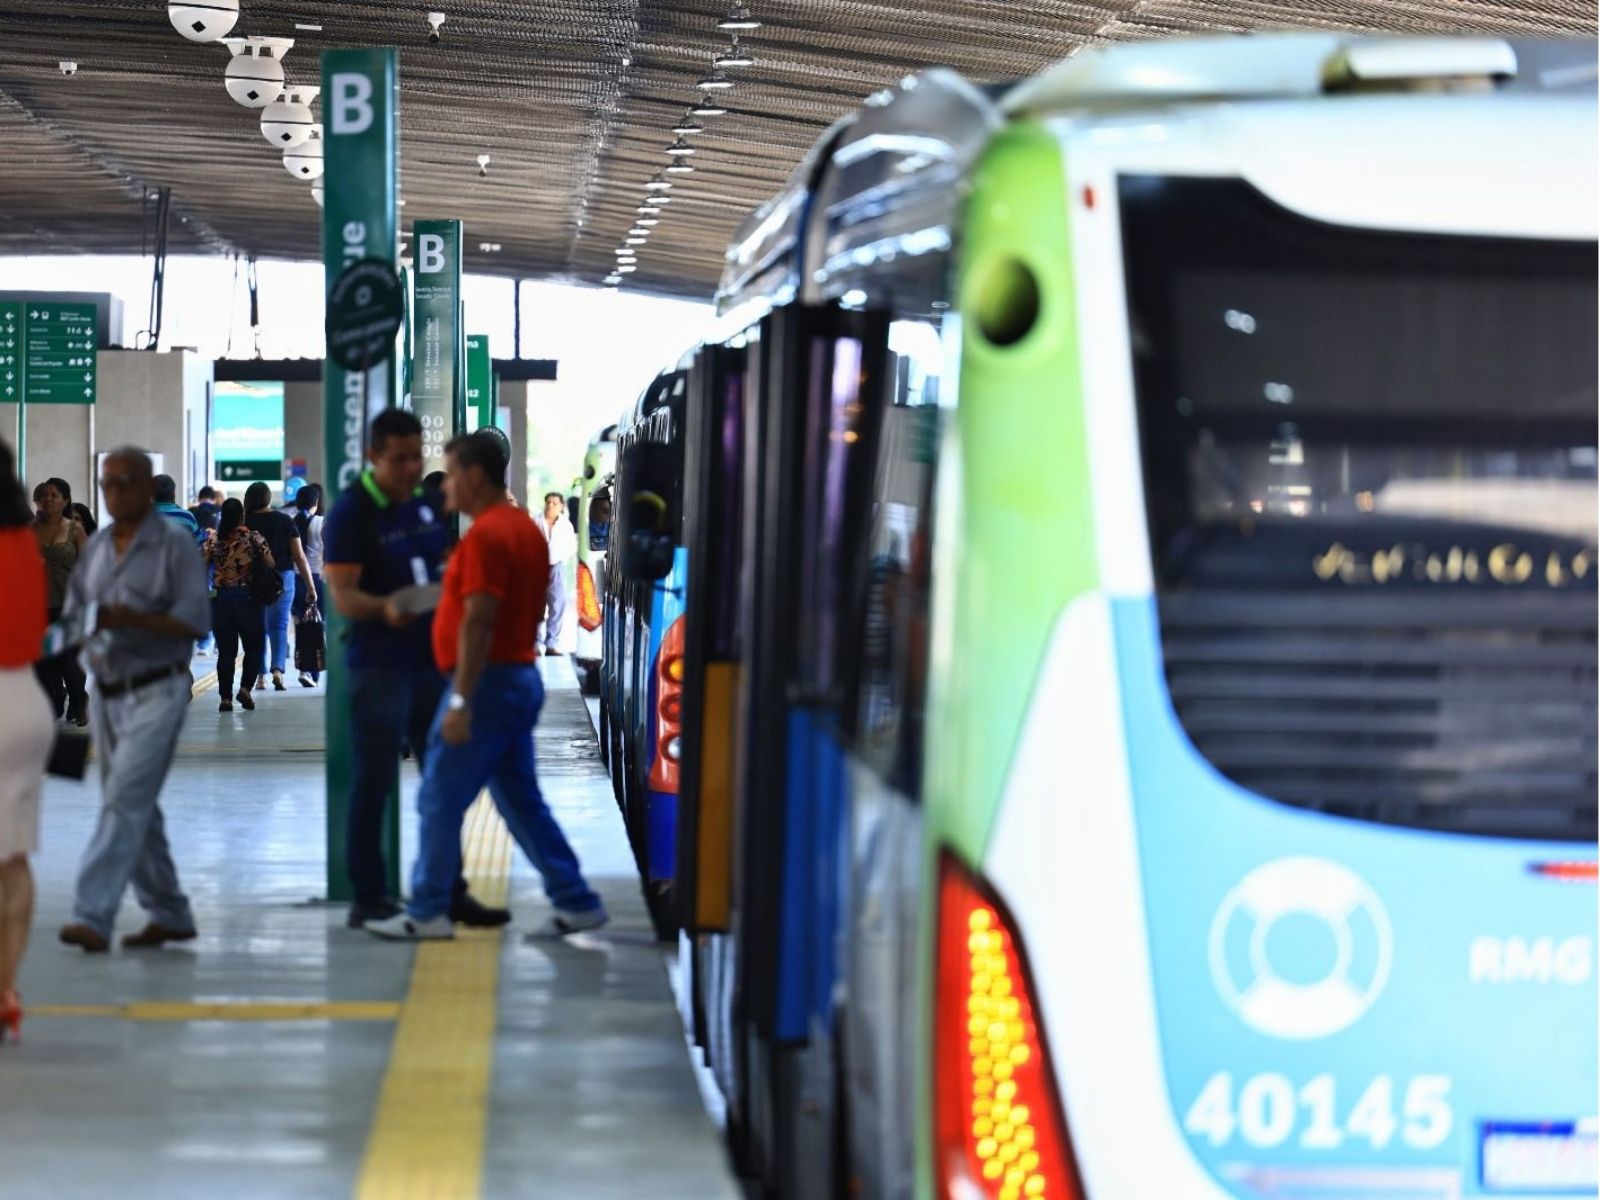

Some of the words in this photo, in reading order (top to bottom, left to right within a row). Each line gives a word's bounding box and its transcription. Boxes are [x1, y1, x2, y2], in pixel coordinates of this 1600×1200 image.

[331, 73, 374, 134] B
[419, 233, 446, 273] B
[336, 222, 366, 490] Desemue
[1470, 936, 1591, 986] RMG
[1186, 1072, 1453, 1150] 40145
